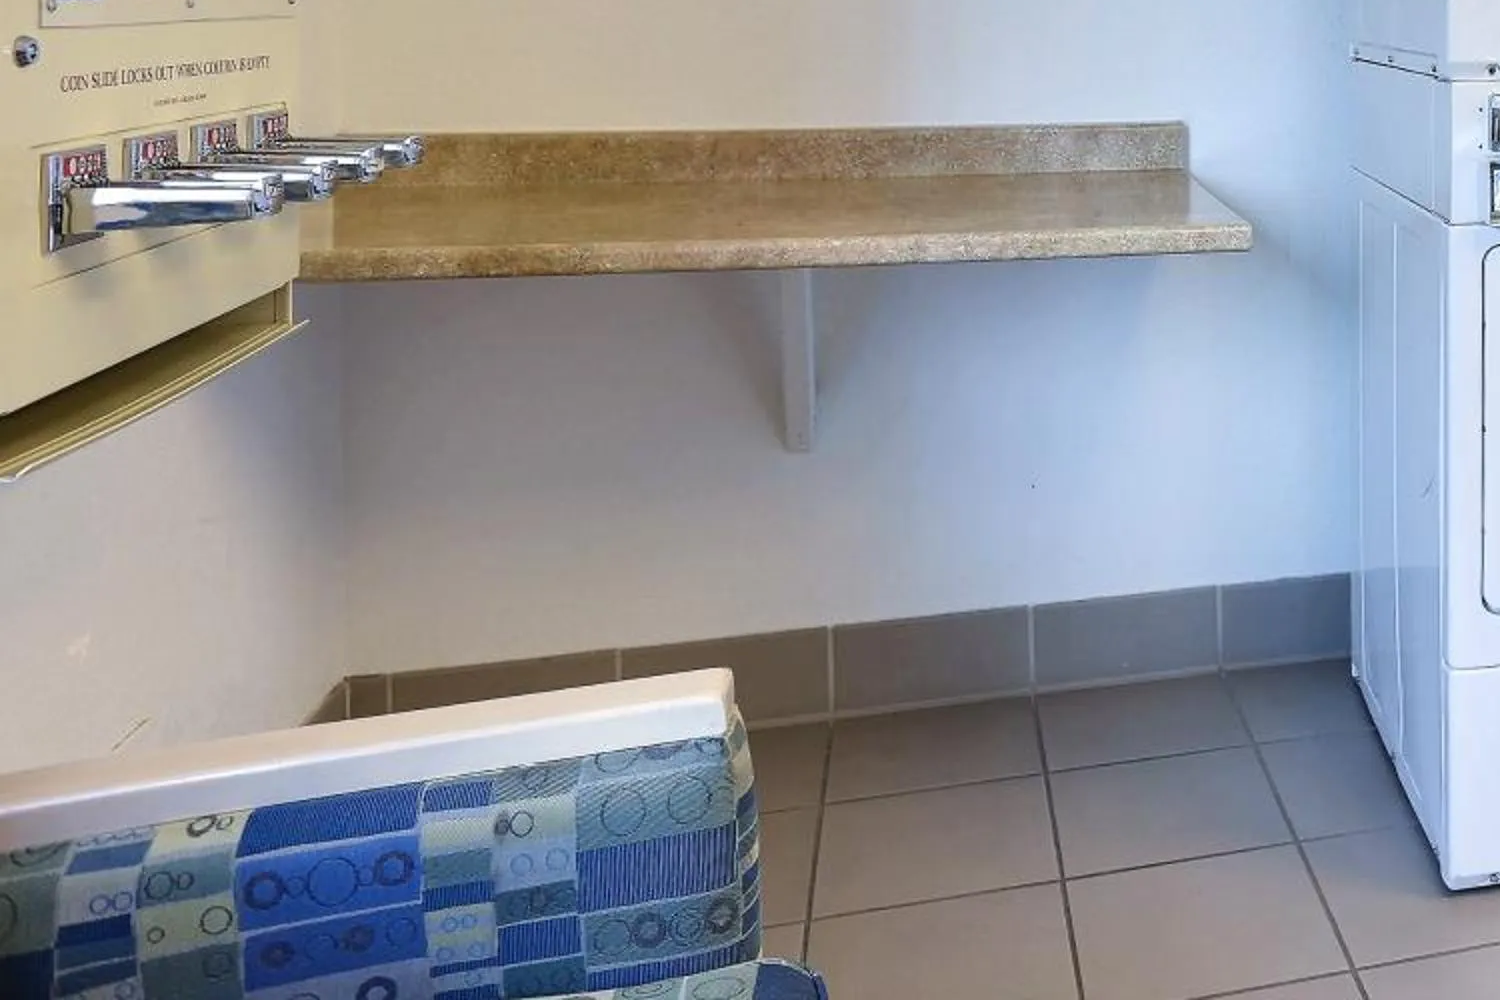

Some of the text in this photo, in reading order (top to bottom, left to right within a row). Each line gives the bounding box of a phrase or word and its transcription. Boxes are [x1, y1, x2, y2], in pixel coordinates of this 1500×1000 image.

[60, 74, 89, 93] COIN
[91, 69, 118, 89] SLIDE
[121, 66, 153, 85] LOCKS
[155, 64, 175, 82] OUT
[177, 62, 202, 79] WHEN
